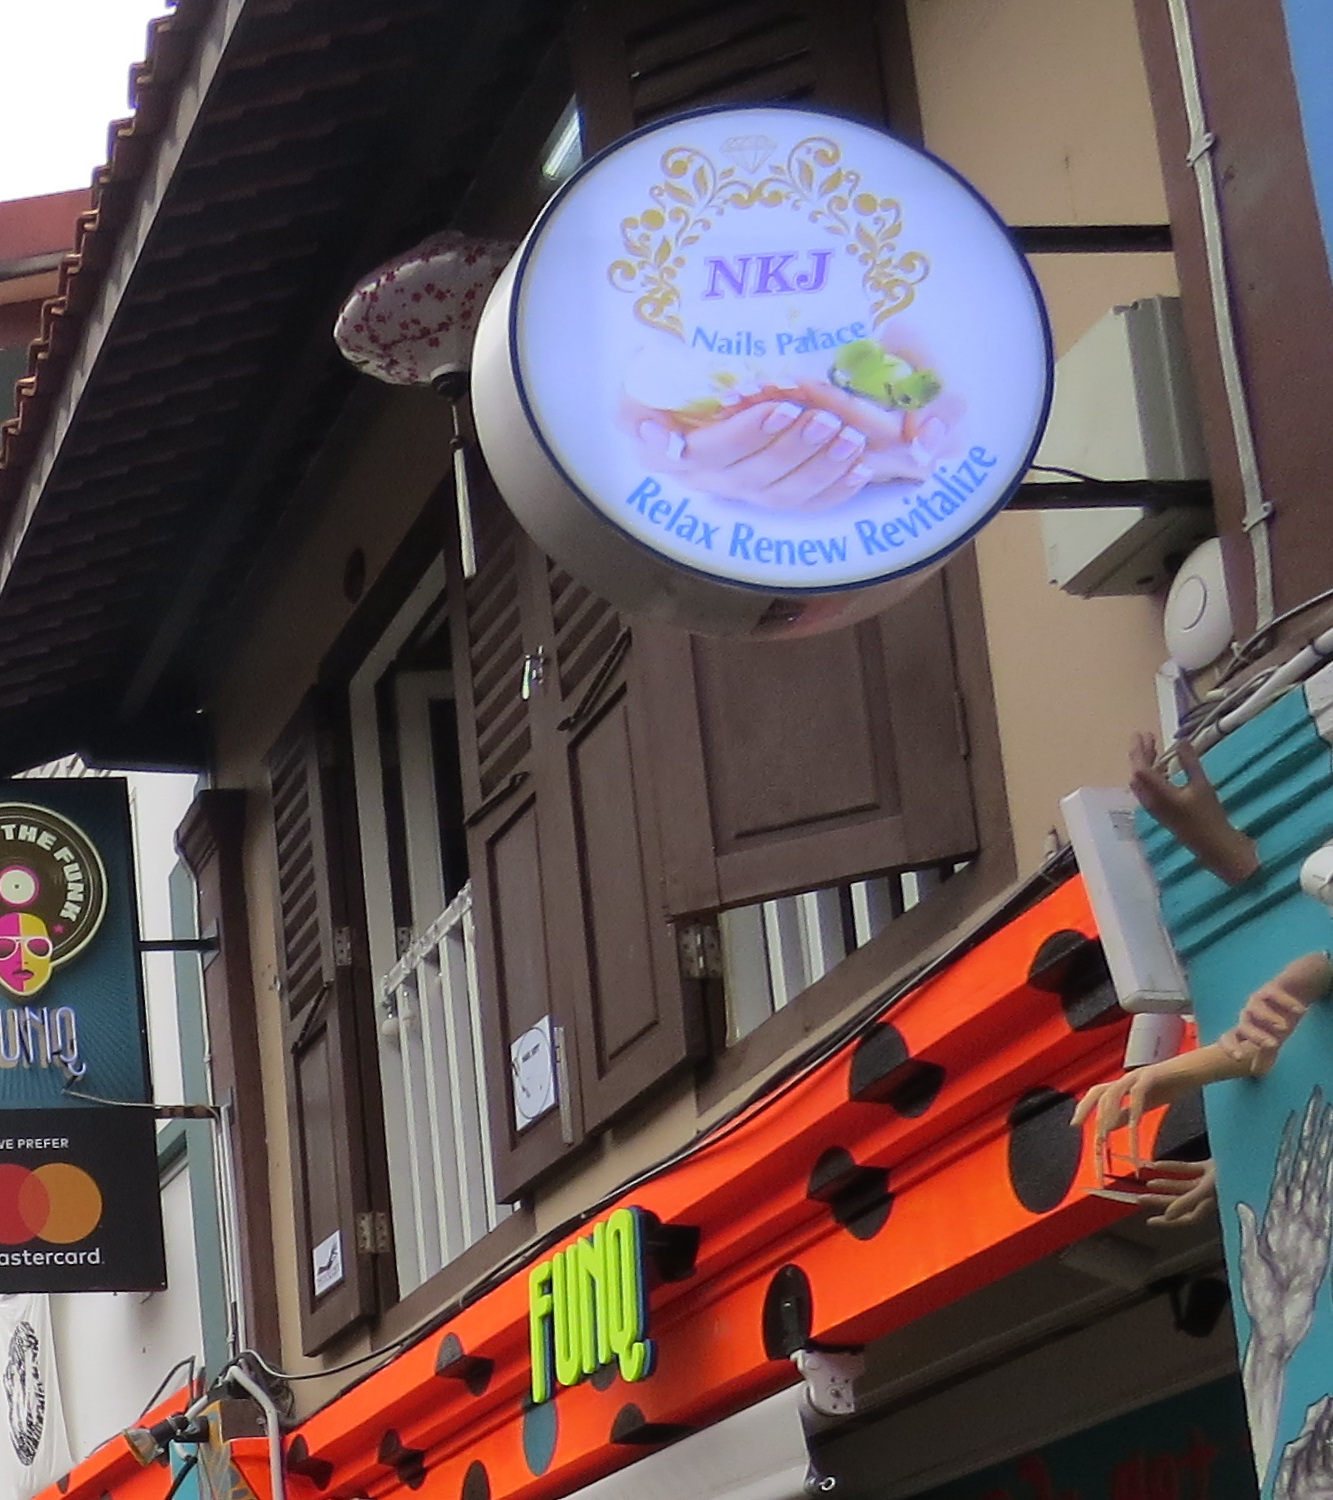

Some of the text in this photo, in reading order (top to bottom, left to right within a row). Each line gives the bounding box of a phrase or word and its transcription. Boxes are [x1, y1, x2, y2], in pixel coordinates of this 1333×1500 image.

[704, 248, 836, 300] NKJ
[691, 319, 867, 358] Nails Palace
[627, 440, 998, 568] Relax Renew Revitalize
[0, 823, 56, 852] THE
[53, 846, 86, 925] FUNK
[17, 1137, 69, 1150] PREFER
[529, 1205, 653, 1403] FUNQ
